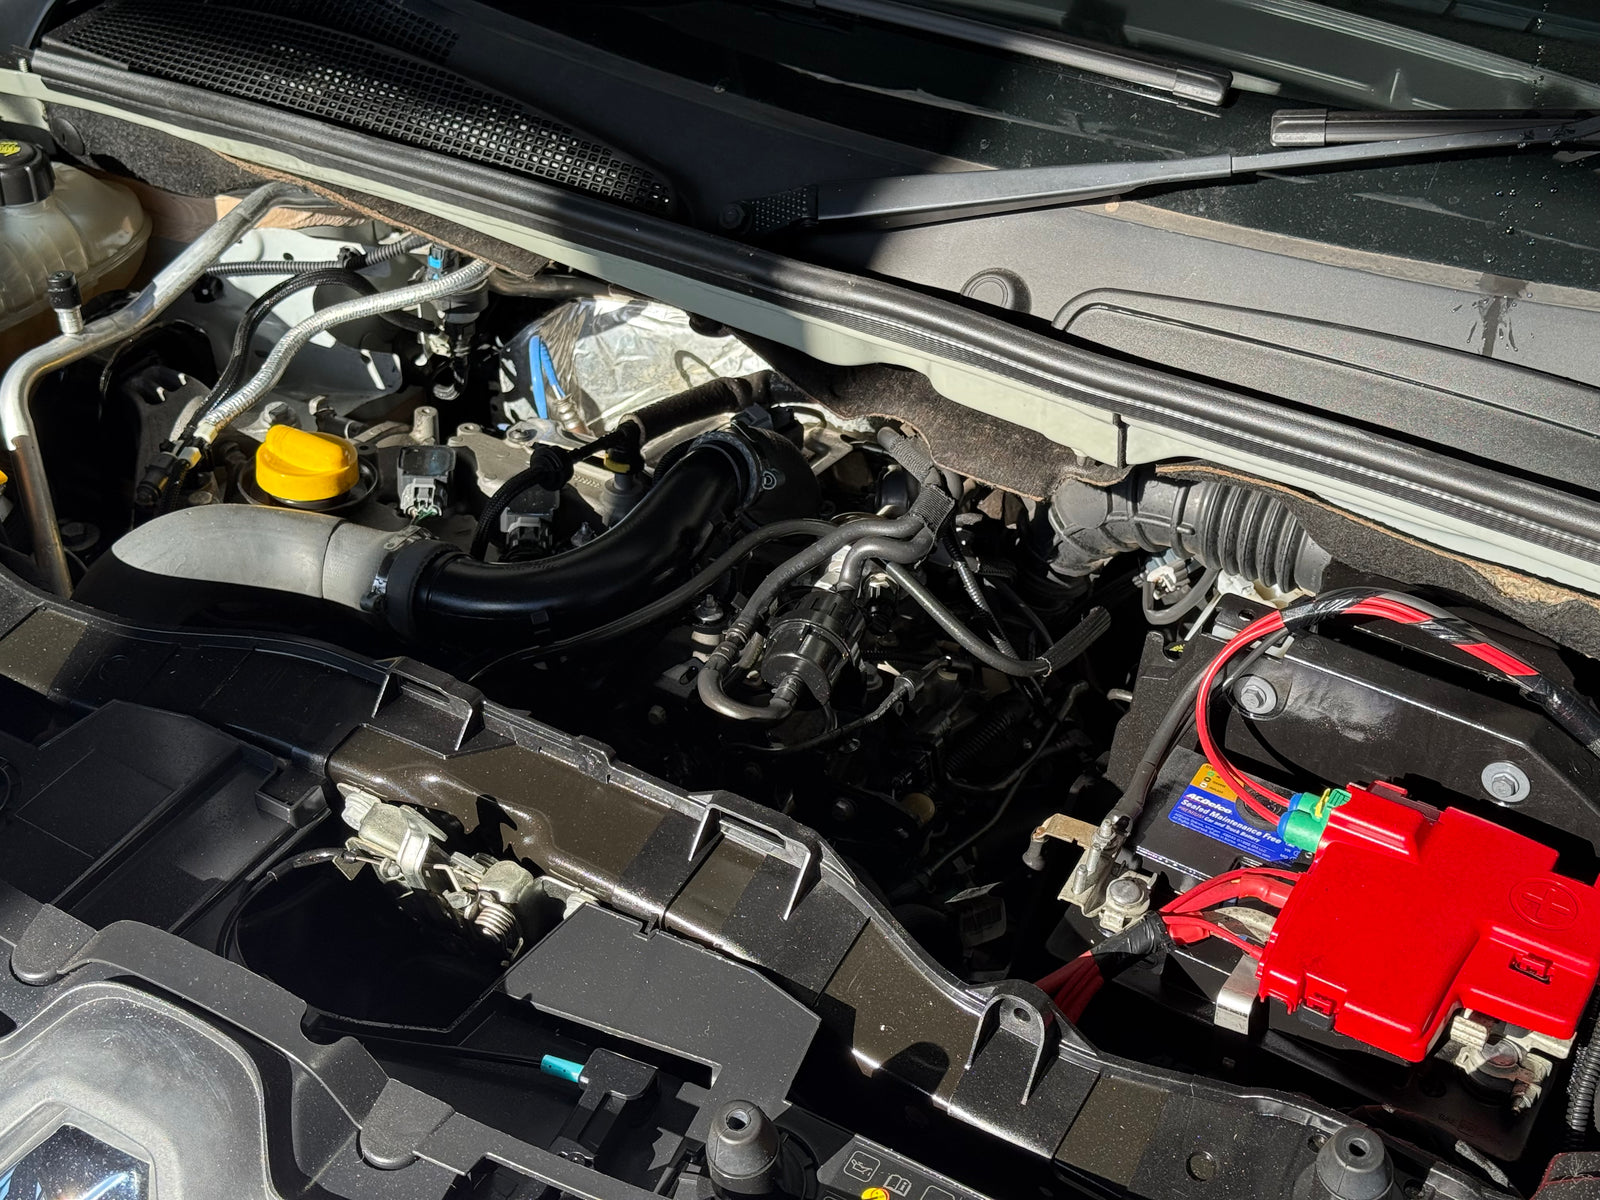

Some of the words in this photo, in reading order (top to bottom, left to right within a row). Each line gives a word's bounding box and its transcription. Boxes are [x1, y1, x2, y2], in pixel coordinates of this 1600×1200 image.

[1185, 792, 1233, 814] ACDelco
[1180, 798, 1209, 814] Sealed
[1209, 811, 1263, 836] Maintenance
[1262, 833, 1282, 844] Free
[1204, 816, 1214, 824] Car
[1225, 826, 1240, 834] Truck
[1240, 832, 1261, 843] Battery
